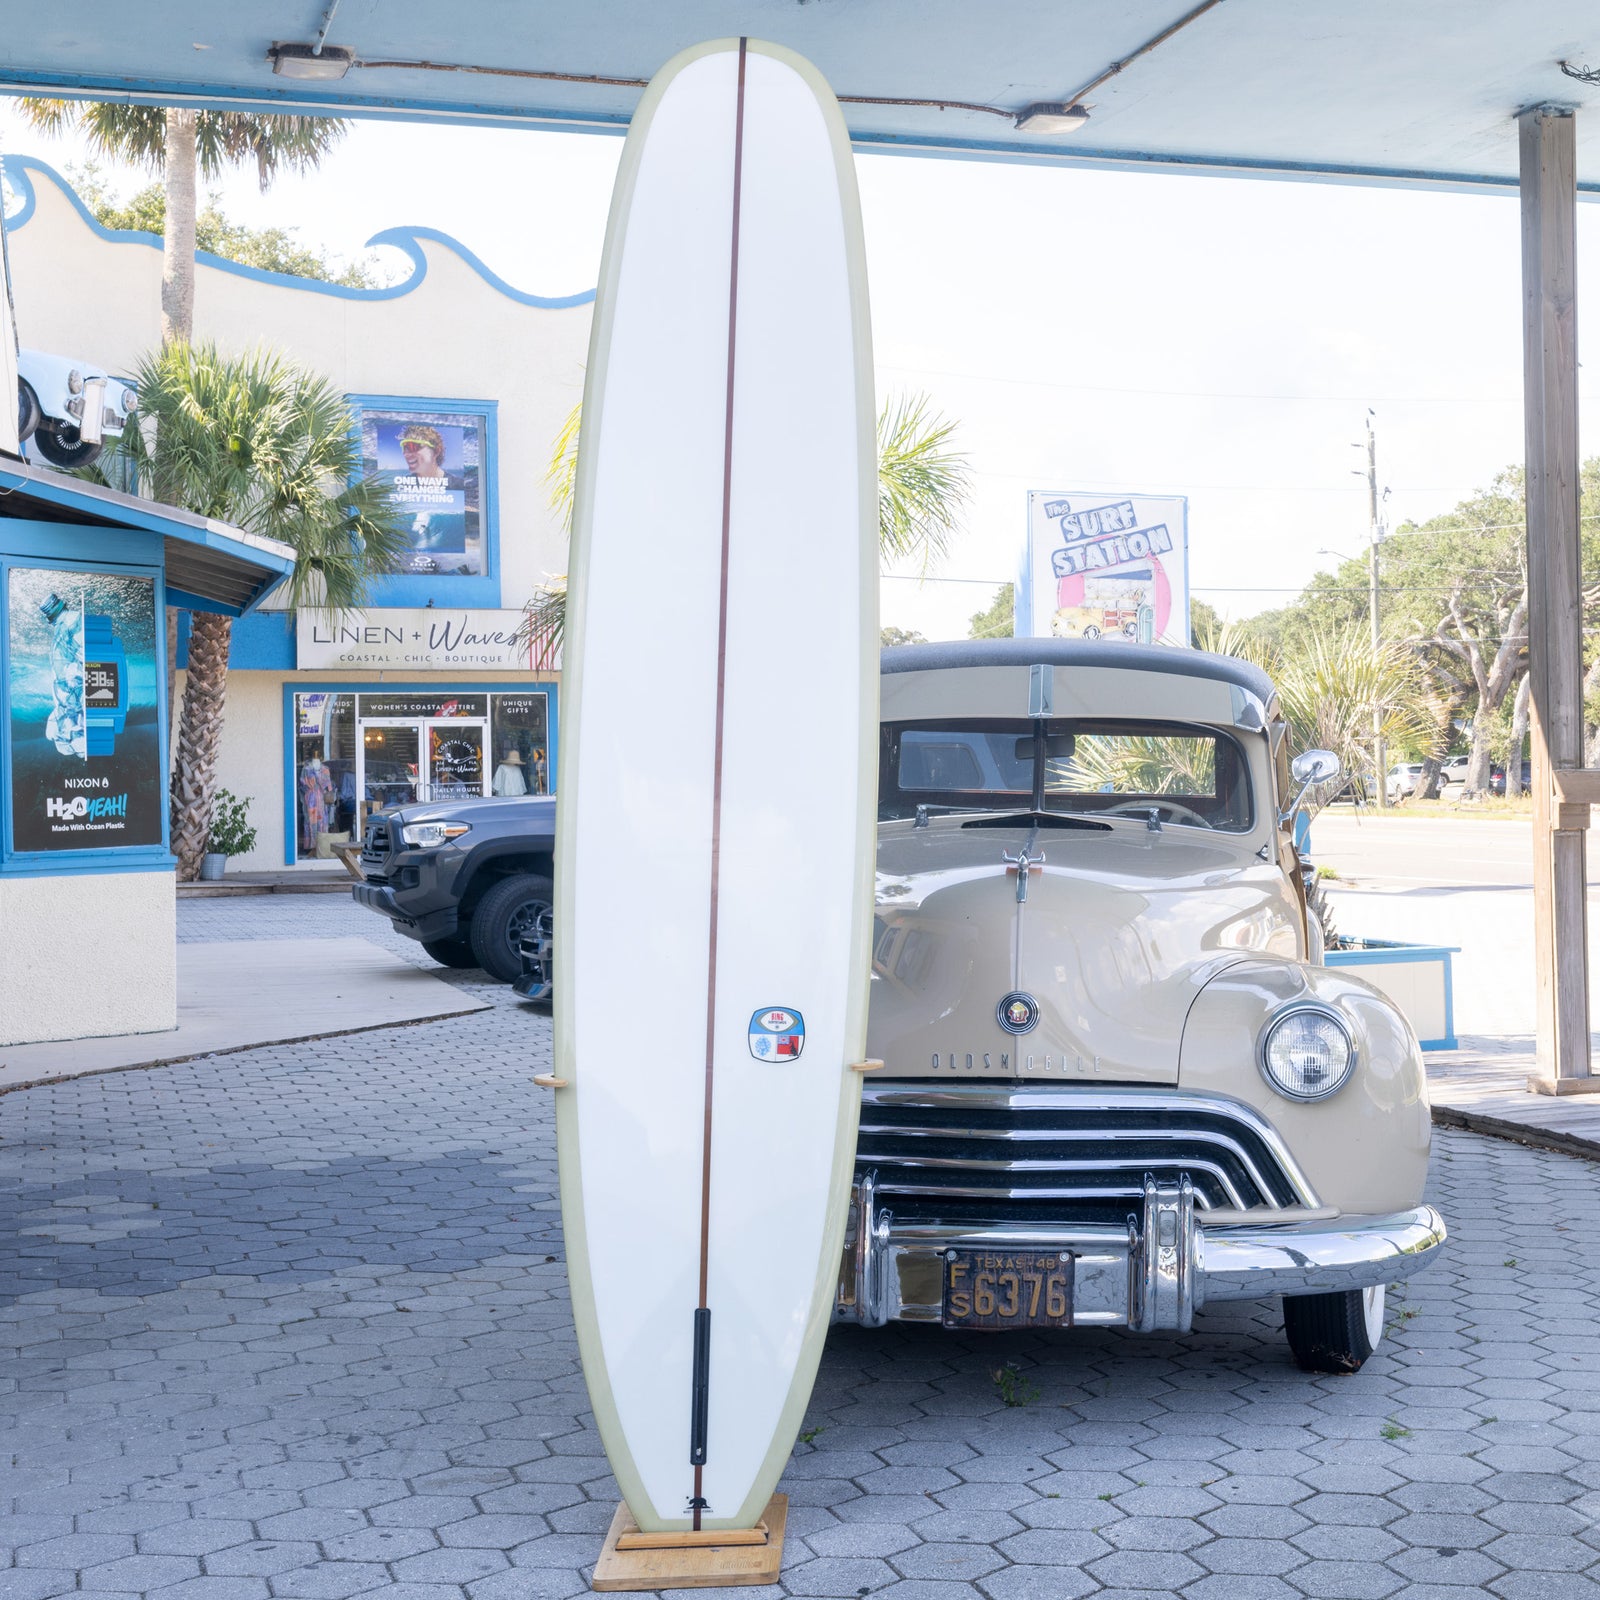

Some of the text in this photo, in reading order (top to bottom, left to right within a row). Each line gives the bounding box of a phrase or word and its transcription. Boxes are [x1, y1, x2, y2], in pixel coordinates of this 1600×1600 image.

[394, 476, 449, 486] ONE WAVE
[397, 485, 446, 495] CHANGES
[389, 493, 454, 503] EVERYTHING
[1046, 502, 1069, 517] The
[1062, 503, 1135, 540] SURF
[1053, 527, 1170, 576] STATION
[313, 626, 403, 644] LINEN
[429, 614, 519, 652] Waves
[339, 654, 502, 664] COASTAL CHIC BOUTIQUE
[437, 740, 476, 753] COASTAL CHIC
[64, 778, 100, 788] NIXON
[69, 823, 85, 831] With
[974, 1271, 1067, 1318] 6376
